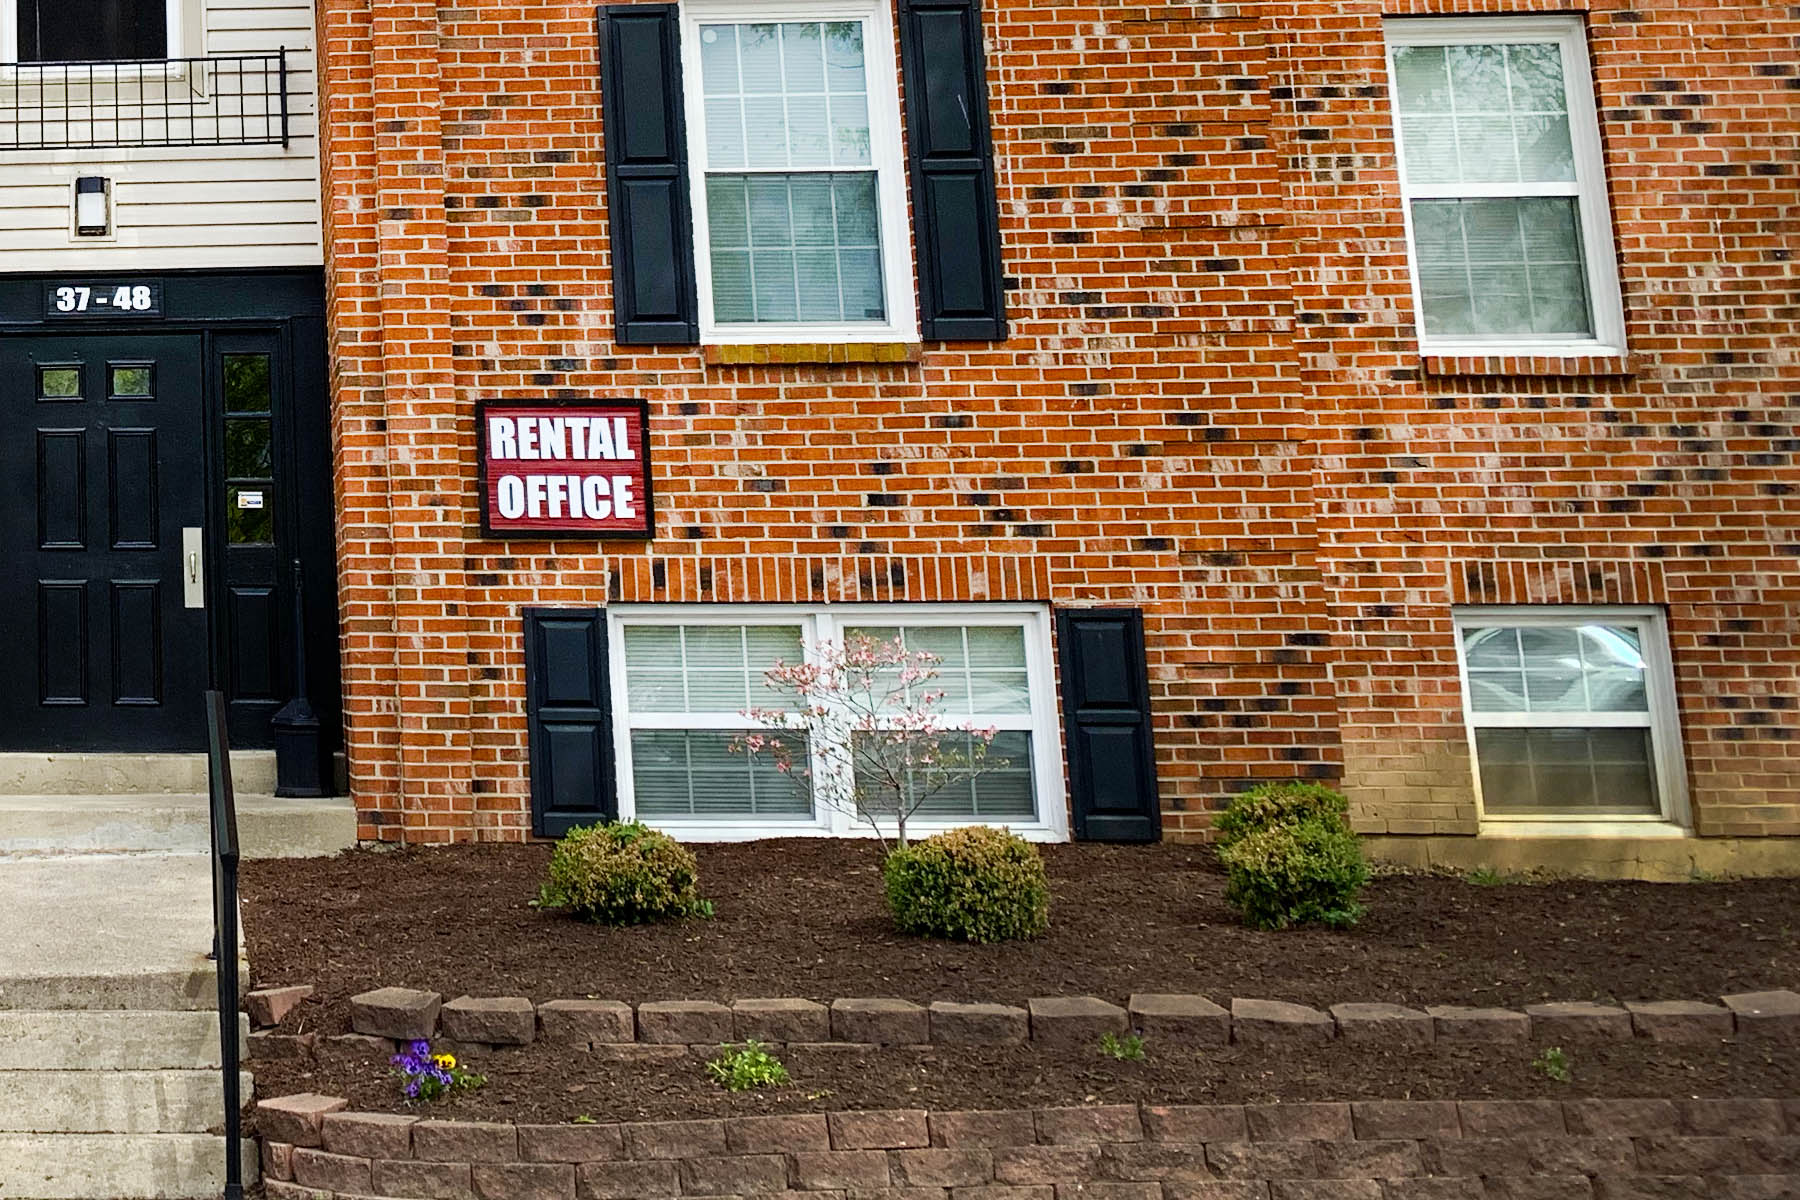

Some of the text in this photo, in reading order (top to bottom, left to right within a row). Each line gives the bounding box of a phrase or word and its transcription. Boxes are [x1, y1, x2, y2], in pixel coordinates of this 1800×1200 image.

[56, 286, 91, 312] 37
[112, 285, 152, 311] 48
[488, 416, 636, 460] RENTAL
[496, 474, 637, 520] OFFICE
